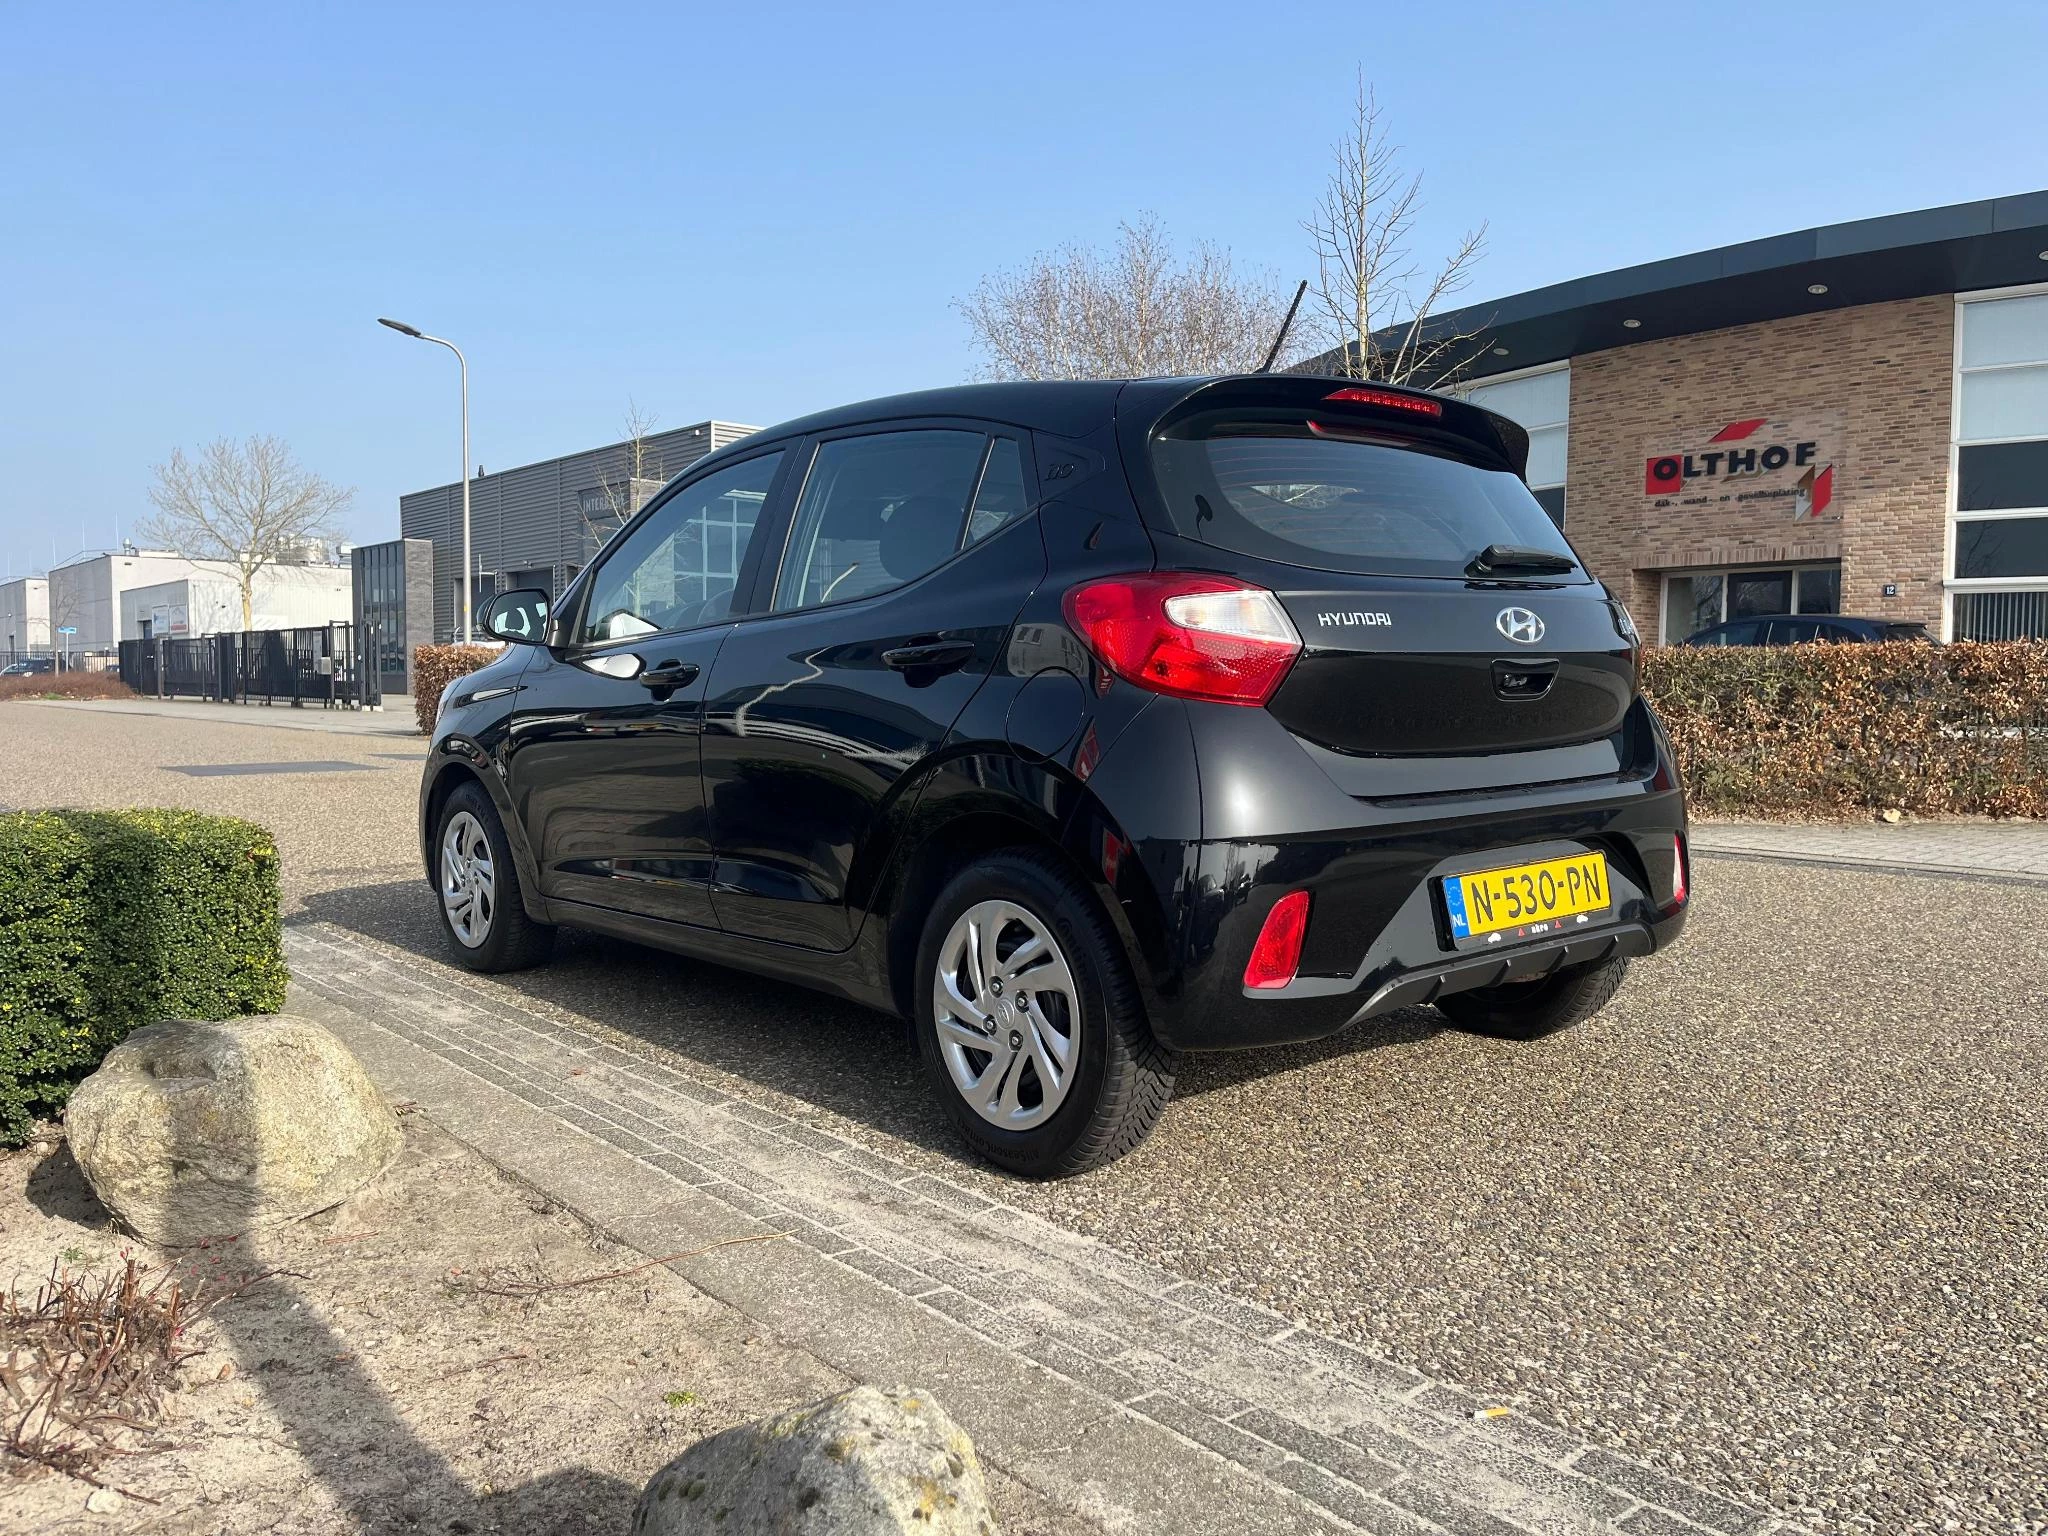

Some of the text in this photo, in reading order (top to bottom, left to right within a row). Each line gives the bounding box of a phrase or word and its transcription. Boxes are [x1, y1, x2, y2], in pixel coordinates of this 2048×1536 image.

[1653, 442, 1816, 480] OLTHOF
[1886, 586, 1895, 595] 12
[1317, 612, 1392, 627] HYUNDAI
[1471, 862, 1602, 924] N-530-PN
[1452, 912, 1467, 927] NL
